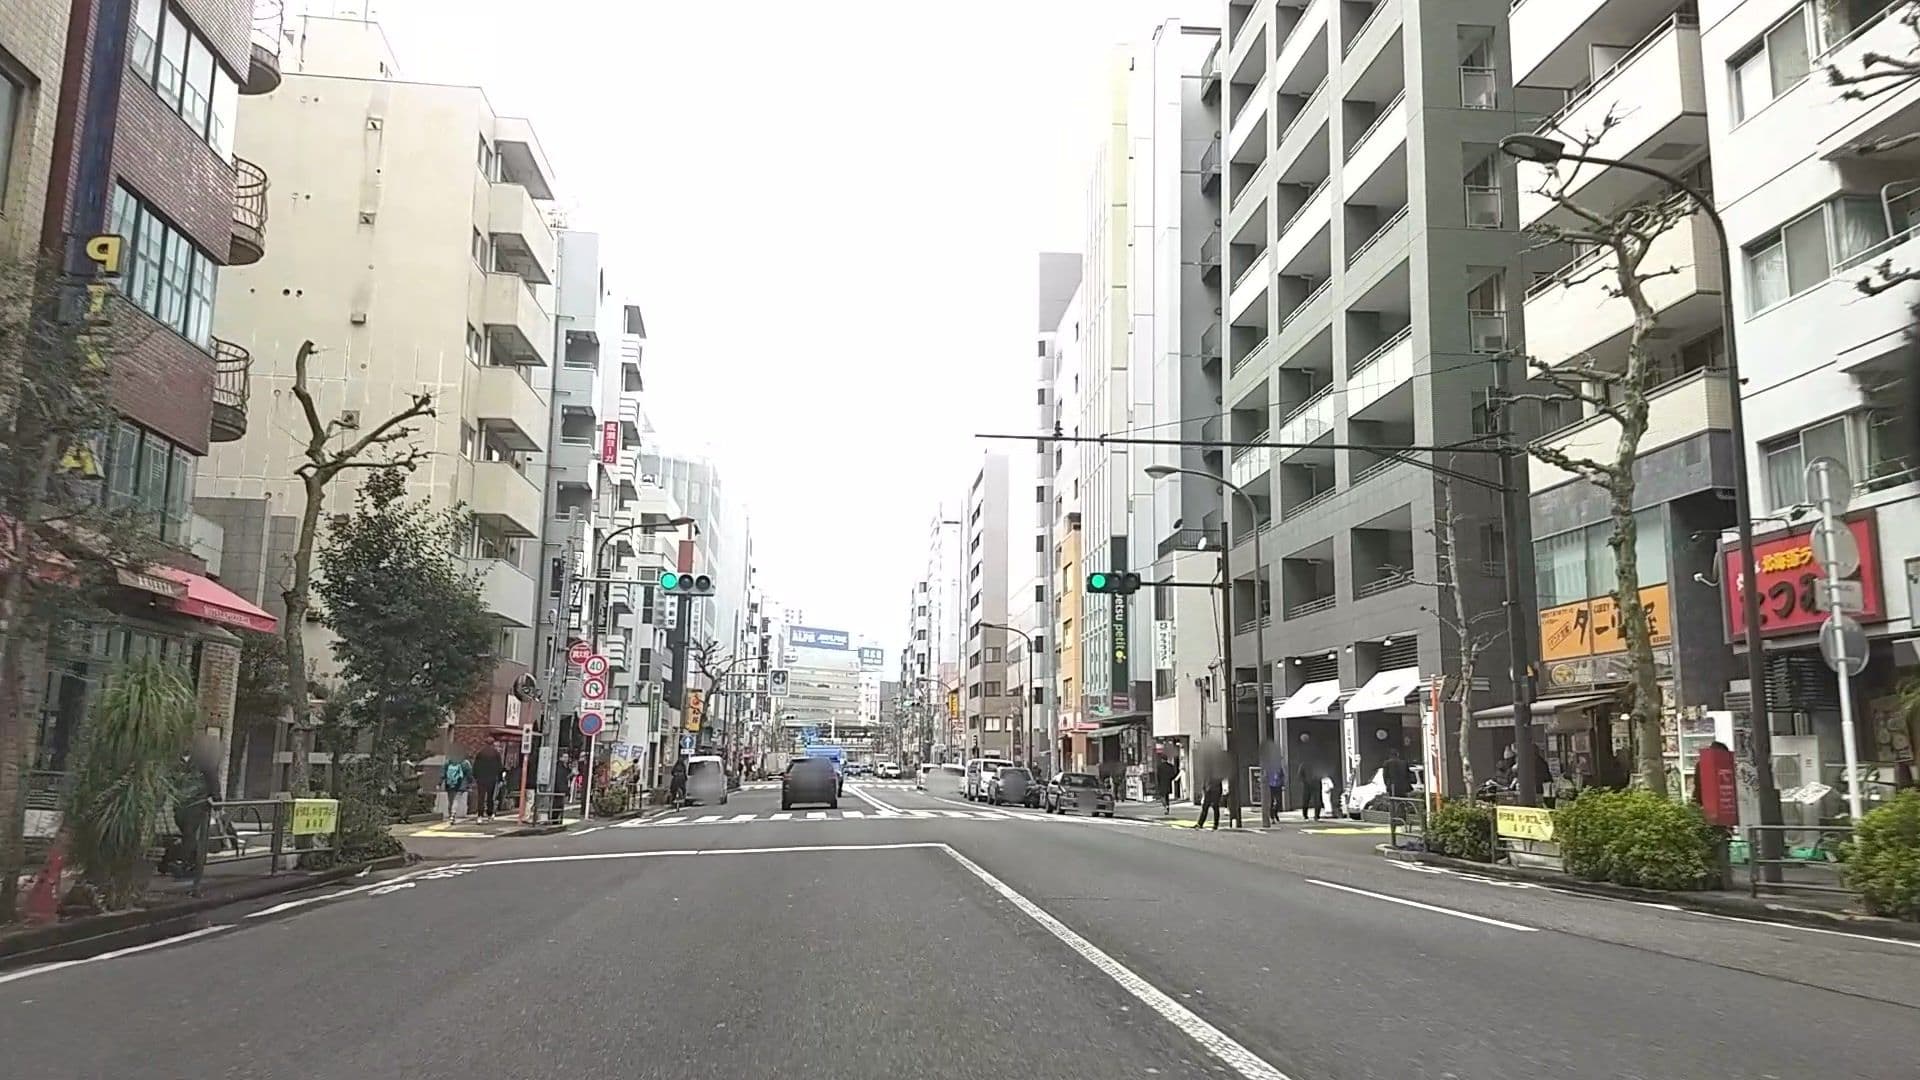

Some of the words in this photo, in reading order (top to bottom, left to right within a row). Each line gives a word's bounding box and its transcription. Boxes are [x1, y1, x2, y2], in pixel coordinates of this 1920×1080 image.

[1761, 546, 1812, 574] 北海道ラ
[1113, 623, 1126, 649] petit
[589, 660, 603, 671] 40
